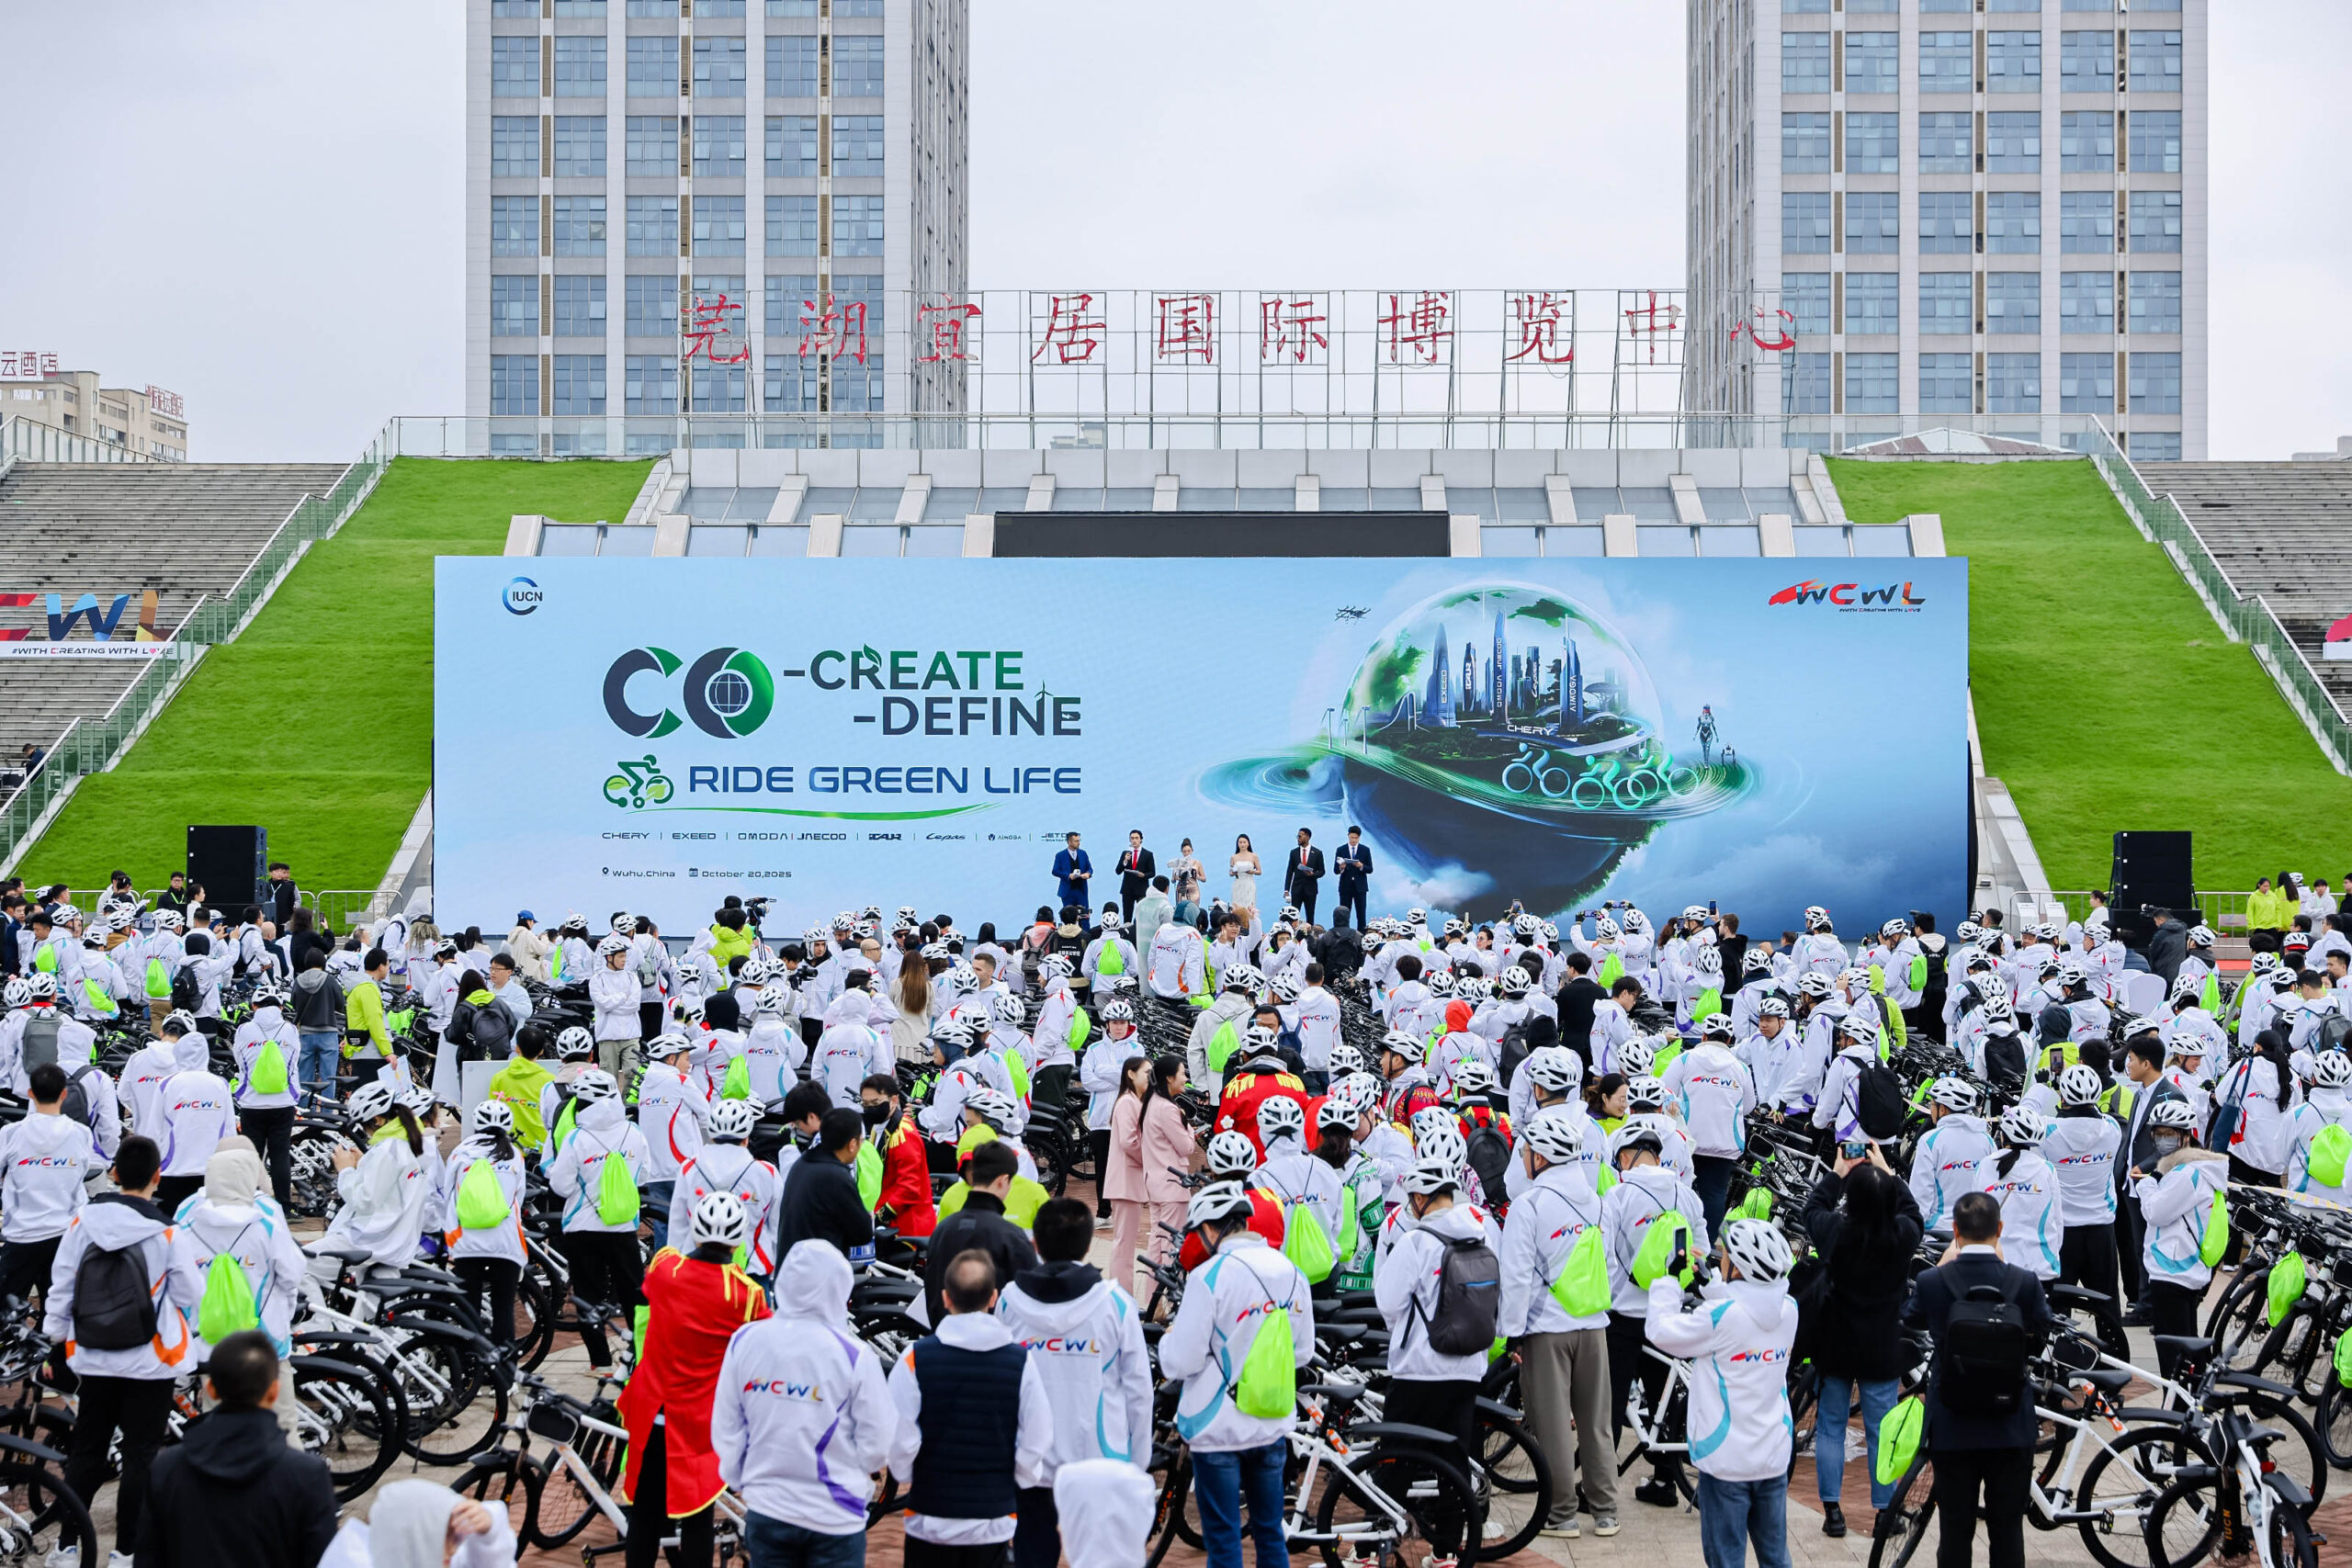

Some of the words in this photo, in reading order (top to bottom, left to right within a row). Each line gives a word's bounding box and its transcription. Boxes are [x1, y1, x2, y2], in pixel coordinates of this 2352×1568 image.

[681, 290, 1796, 367] 芜湖宜居国际博览中心
[512, 591, 543, 602] IUCN
[1794, 582, 1926, 604] WCWL
[12, 647, 48, 655] #WITH
[51, 647, 106, 655] CREATING
[108, 647, 138, 655] WITH
[603, 647, 775, 739] CO
[1507, 724, 1555, 736] CHERY
[689, 766, 794, 794] RIDE
[808, 766, 968, 794] GREEN
[984, 766, 1081, 794] LIFE
[751, 1047, 780, 1055] WCWL
[831, 1049, 864, 1057] WCWL
[1700, 1077, 1739, 1088] WCWL
[181, 1100, 221, 1110] WCWL
[28, 1156, 77, 1167] WCWL
[2068, 1152, 2113, 1164] WCWL
[1994, 1183, 2042, 1192] WCWL
[1026, 1338, 1101, 1354] WCWL
[752, 1380, 823, 1402] WCWL
